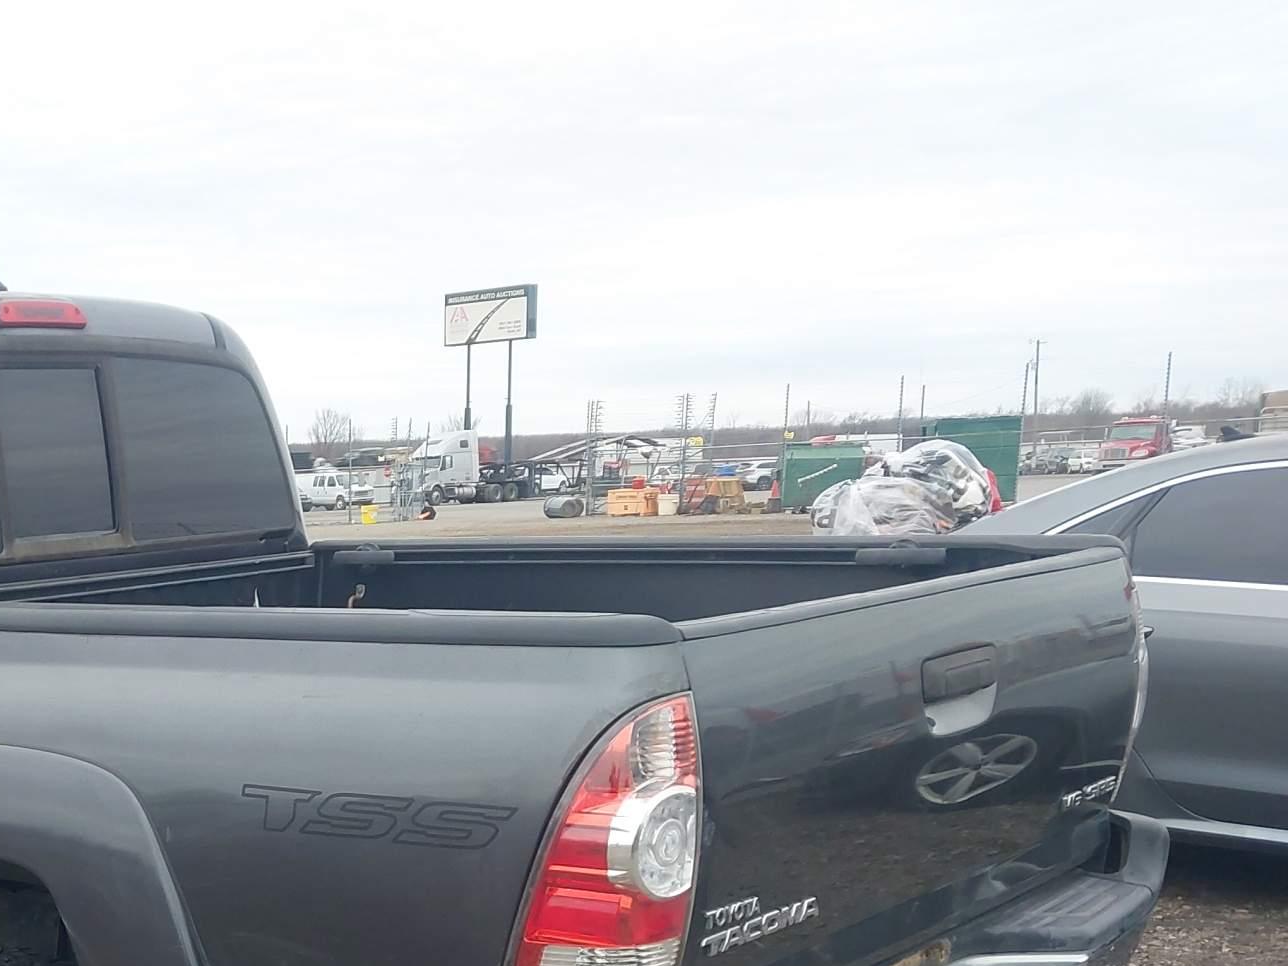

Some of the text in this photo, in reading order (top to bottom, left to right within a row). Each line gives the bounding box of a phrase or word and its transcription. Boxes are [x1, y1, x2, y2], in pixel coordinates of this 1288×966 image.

[241, 783, 518, 849] TSS
[700, 896, 819, 957] TACOMA
[705, 896, 761, 929] TOYOTA
